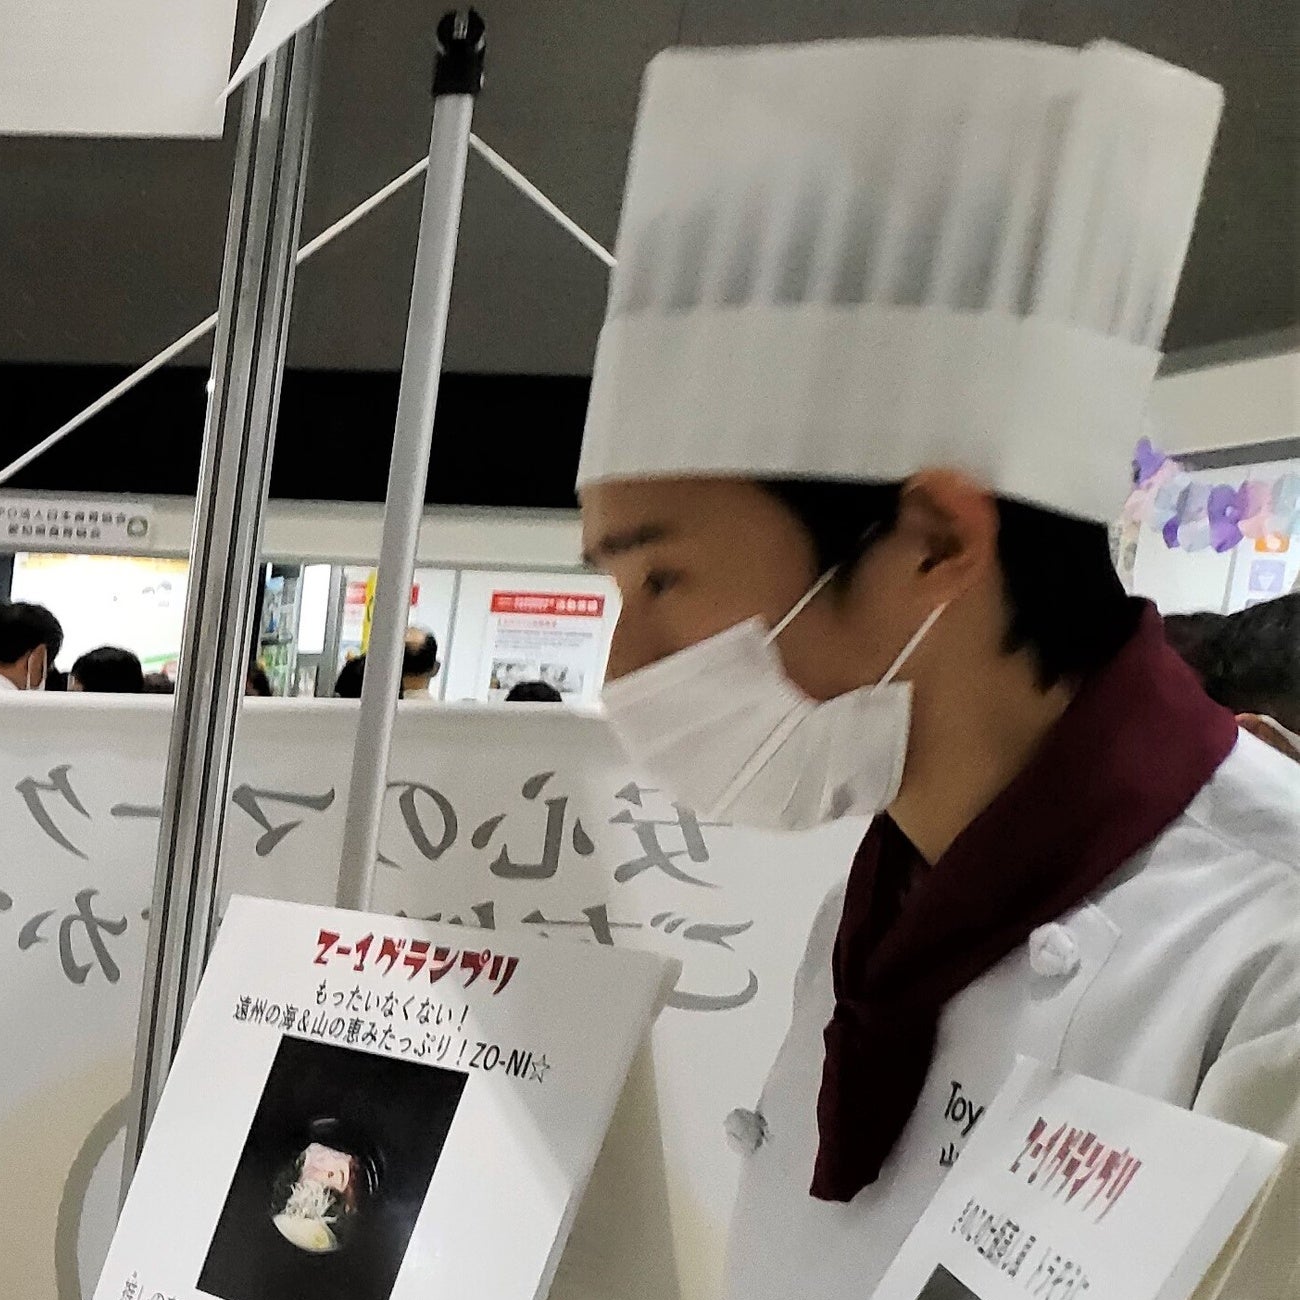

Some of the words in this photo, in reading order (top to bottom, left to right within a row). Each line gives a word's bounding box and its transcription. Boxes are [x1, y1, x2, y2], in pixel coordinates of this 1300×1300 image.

[315, 979, 469, 1032] もったいなくない！
